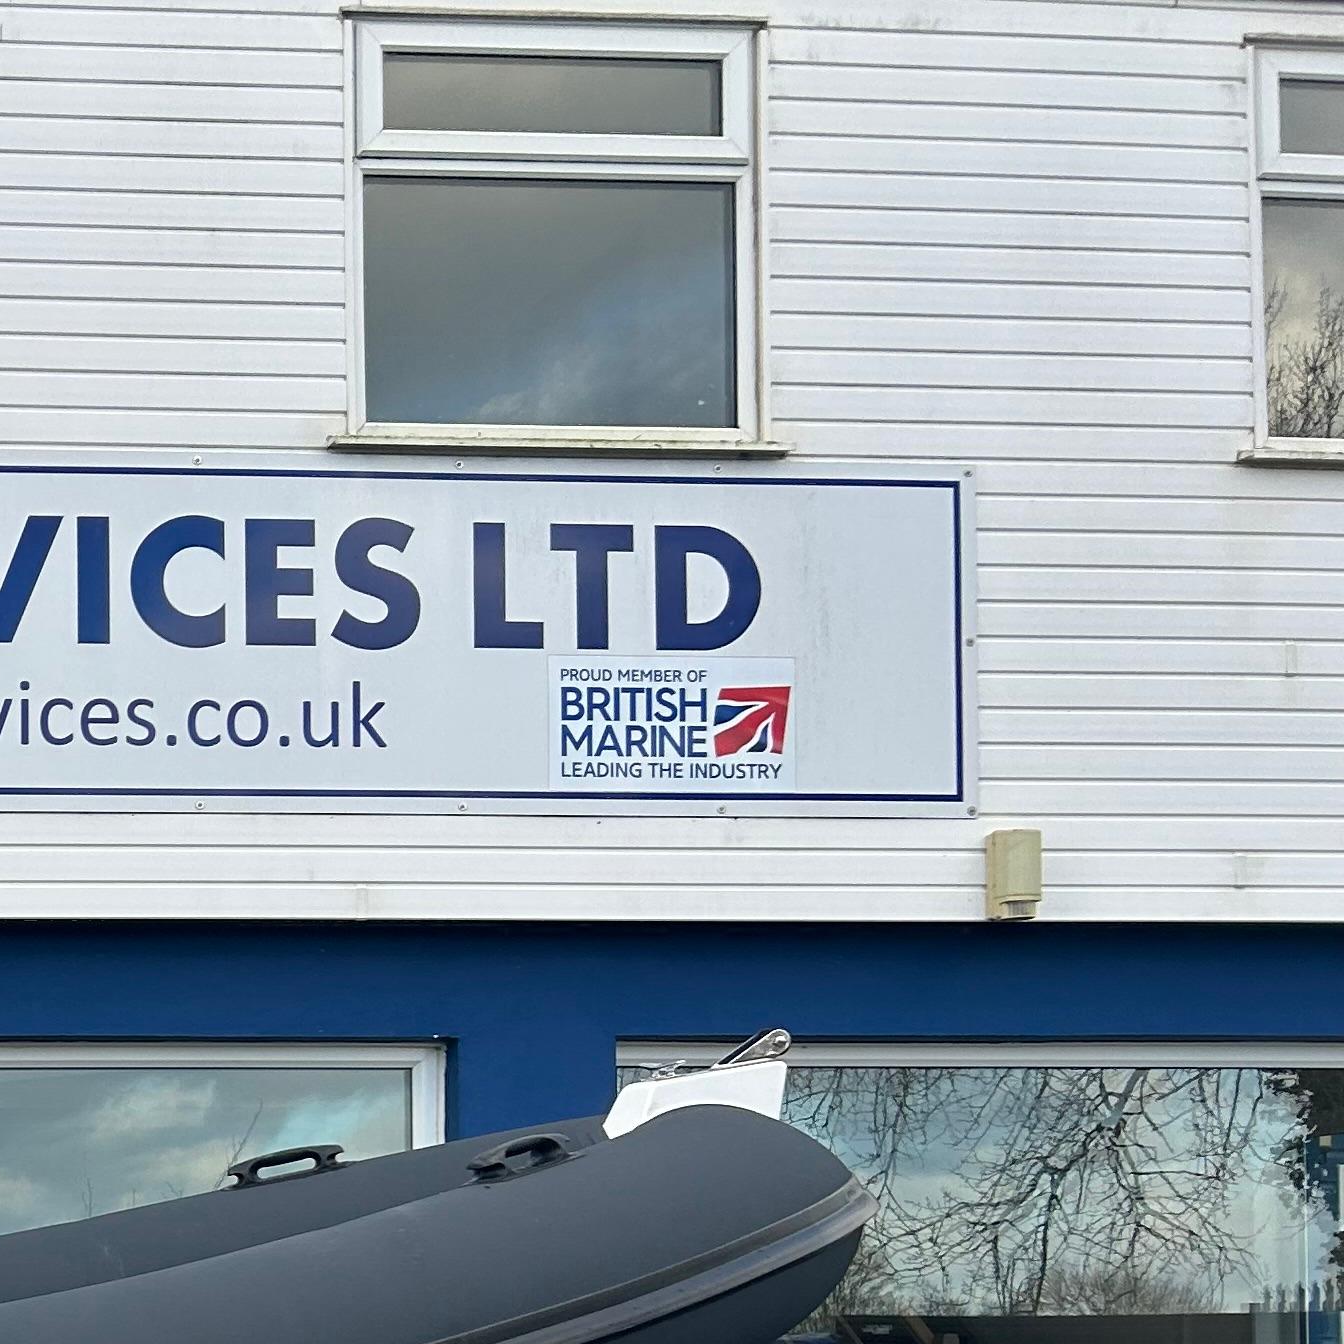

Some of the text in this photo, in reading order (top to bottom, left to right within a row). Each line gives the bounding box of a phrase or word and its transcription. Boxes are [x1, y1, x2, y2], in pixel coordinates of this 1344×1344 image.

[473, 522, 761, 650] LTD
[560, 668, 707, 682] PROUD MEMBER OF
[561, 687, 707, 722] BRITISH
[562, 725, 707, 757] MARINE
[561, 762, 783, 779] LEADING THE INDUSTRY
